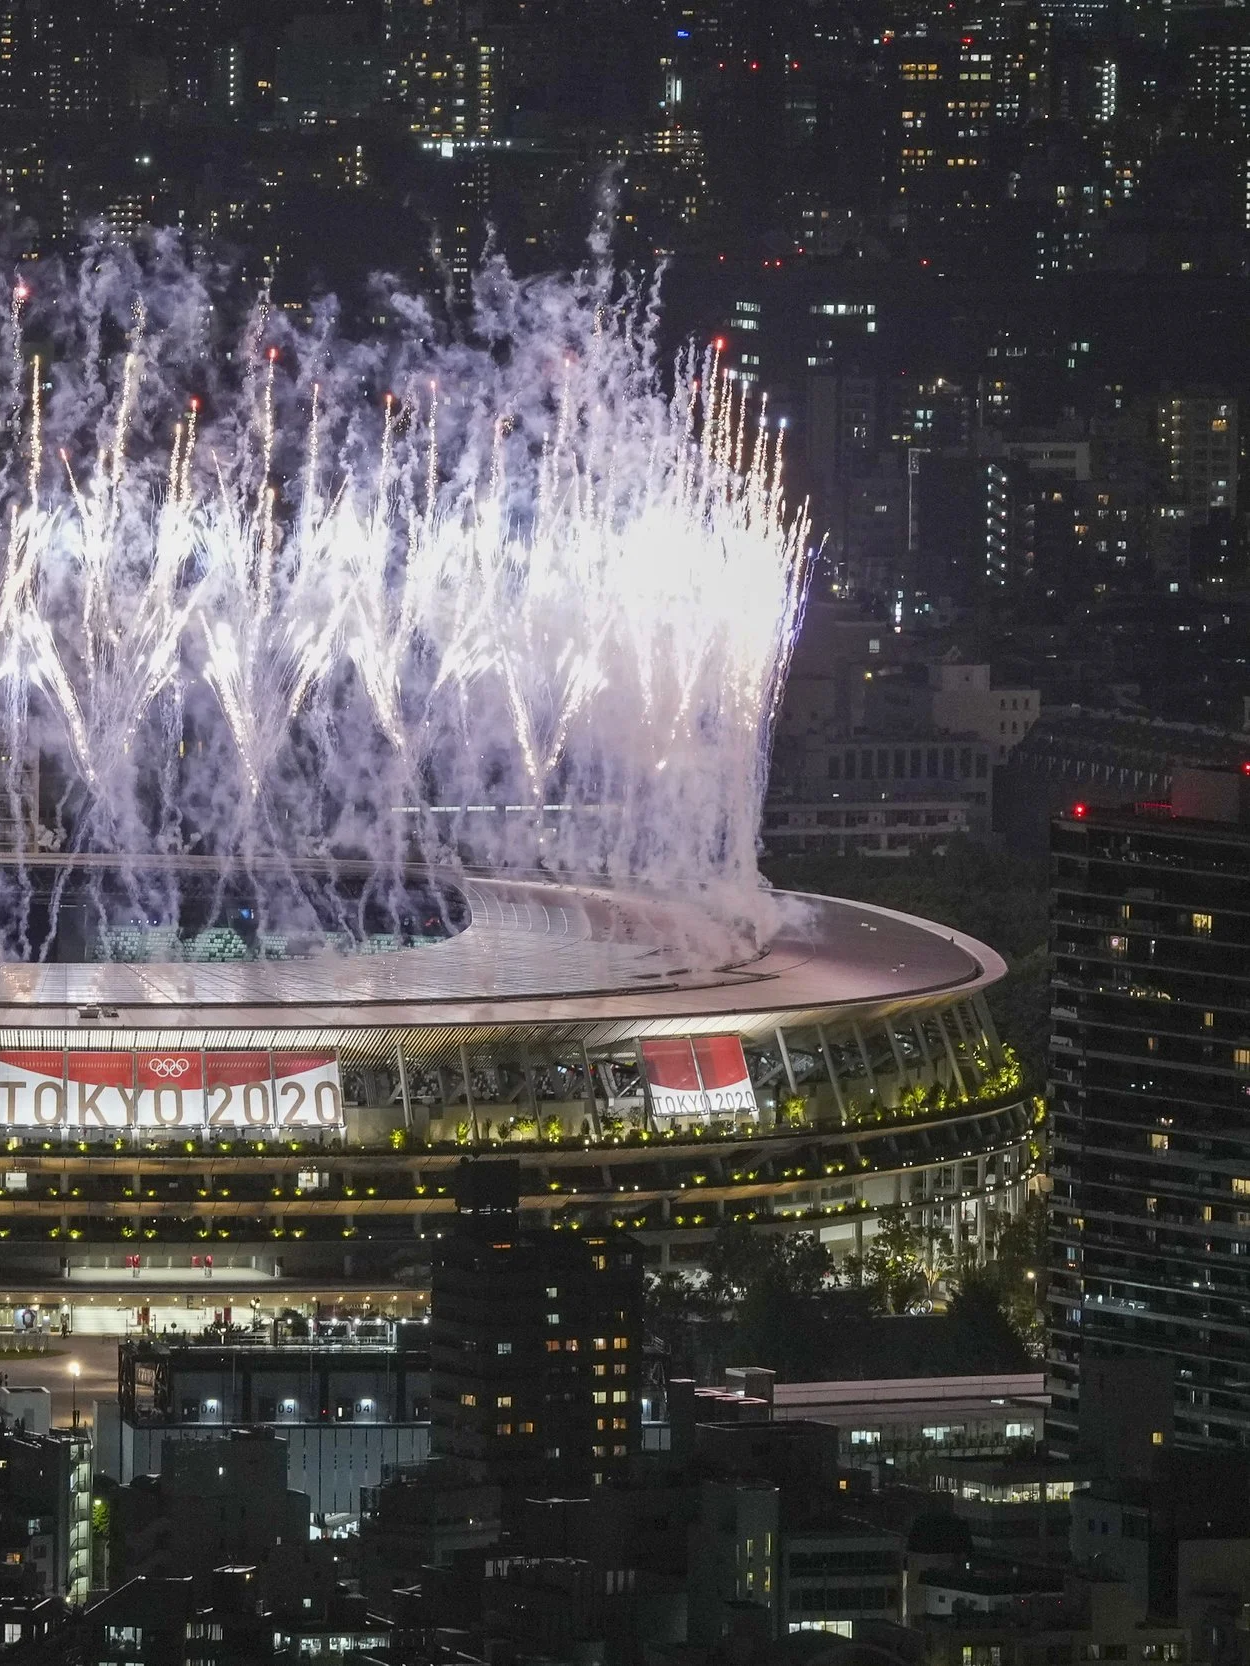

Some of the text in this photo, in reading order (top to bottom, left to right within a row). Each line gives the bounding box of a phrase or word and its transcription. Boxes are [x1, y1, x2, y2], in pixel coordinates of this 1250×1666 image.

[206, 1080, 343, 1126] 2020
[653, 1090, 757, 1114] TOKYO 2020
[200, 1403, 216, 1414] 06
[277, 1403, 294, 1414] 05
[354, 1403, 370, 1414] 04
